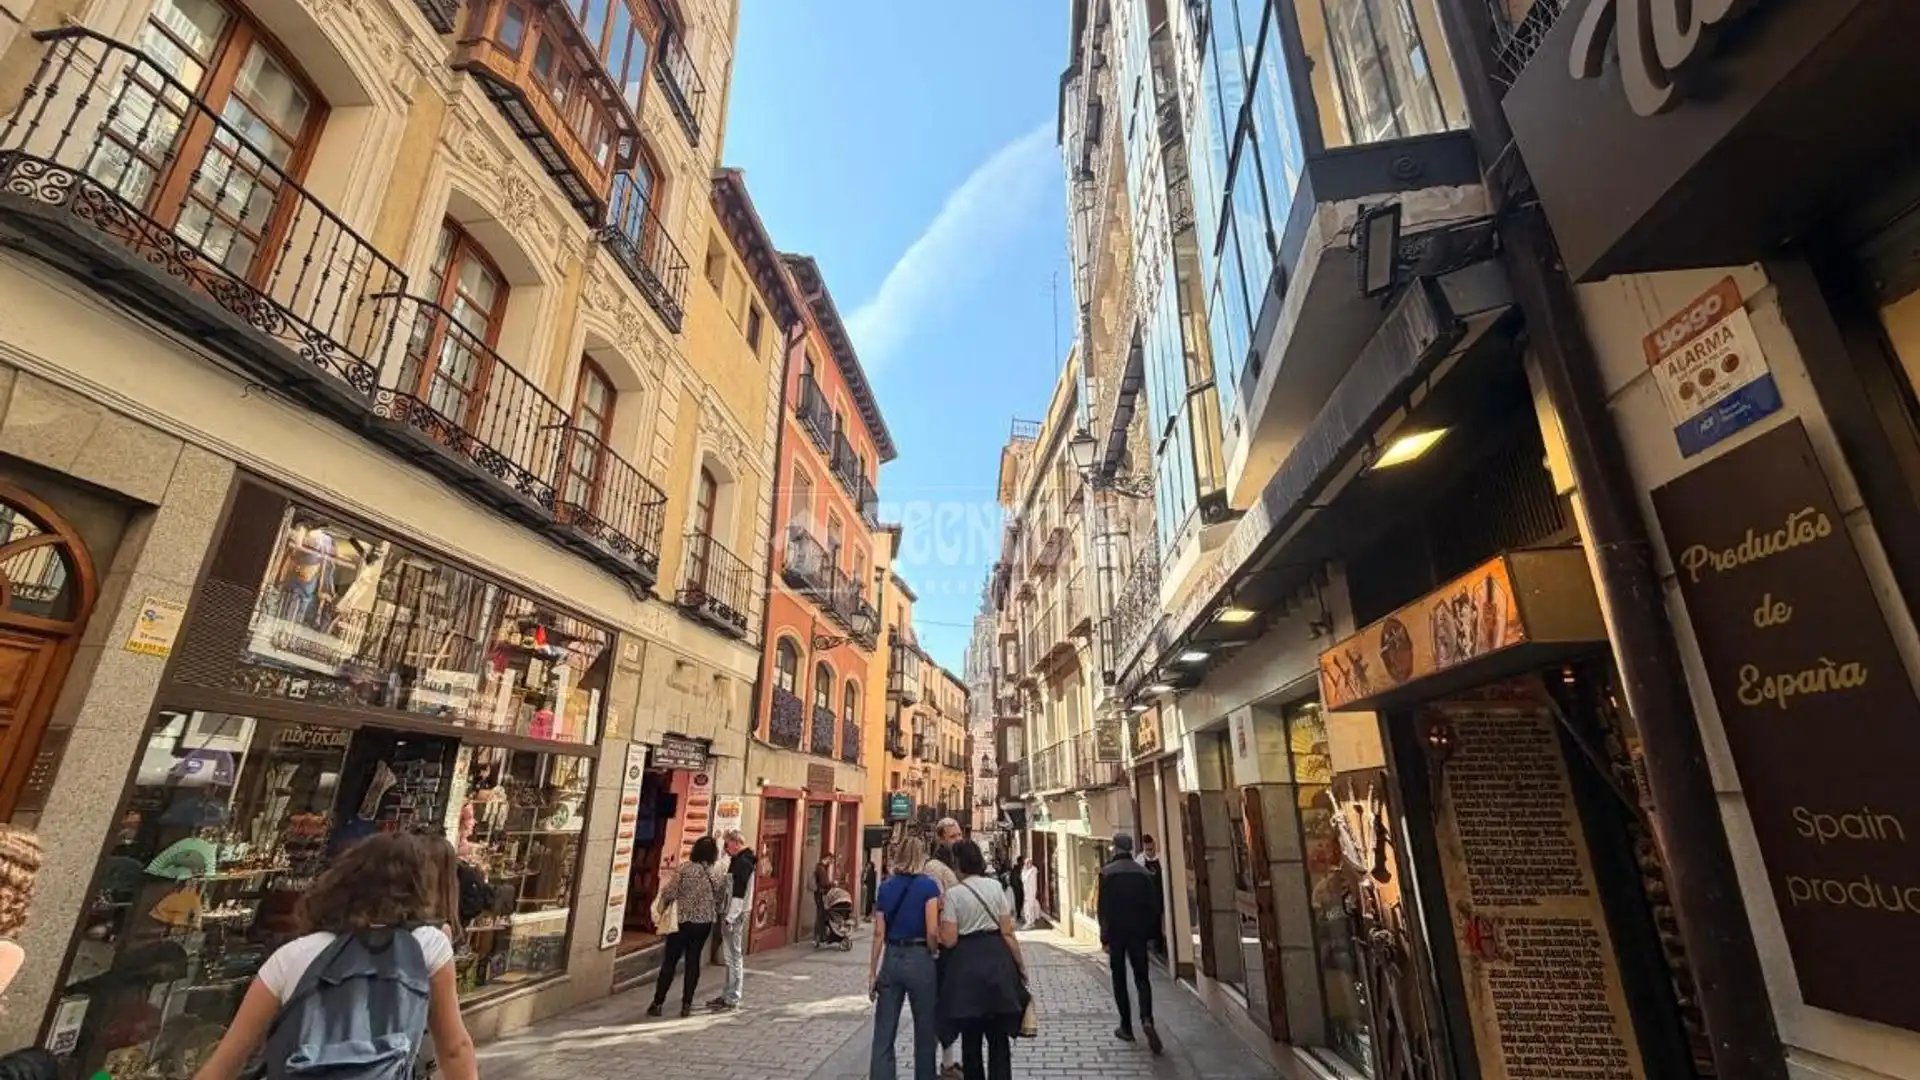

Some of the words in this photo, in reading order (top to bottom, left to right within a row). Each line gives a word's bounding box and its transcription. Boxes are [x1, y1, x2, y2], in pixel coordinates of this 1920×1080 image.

[1655, 294, 1723, 353] yoigo
[1668, 326, 1734, 378] ALARMA
[1680, 506, 1832, 583] Productos
[1753, 593, 1792, 628] de
[1738, 657, 1867, 709] España
[1792, 806, 1905, 844] Spain
